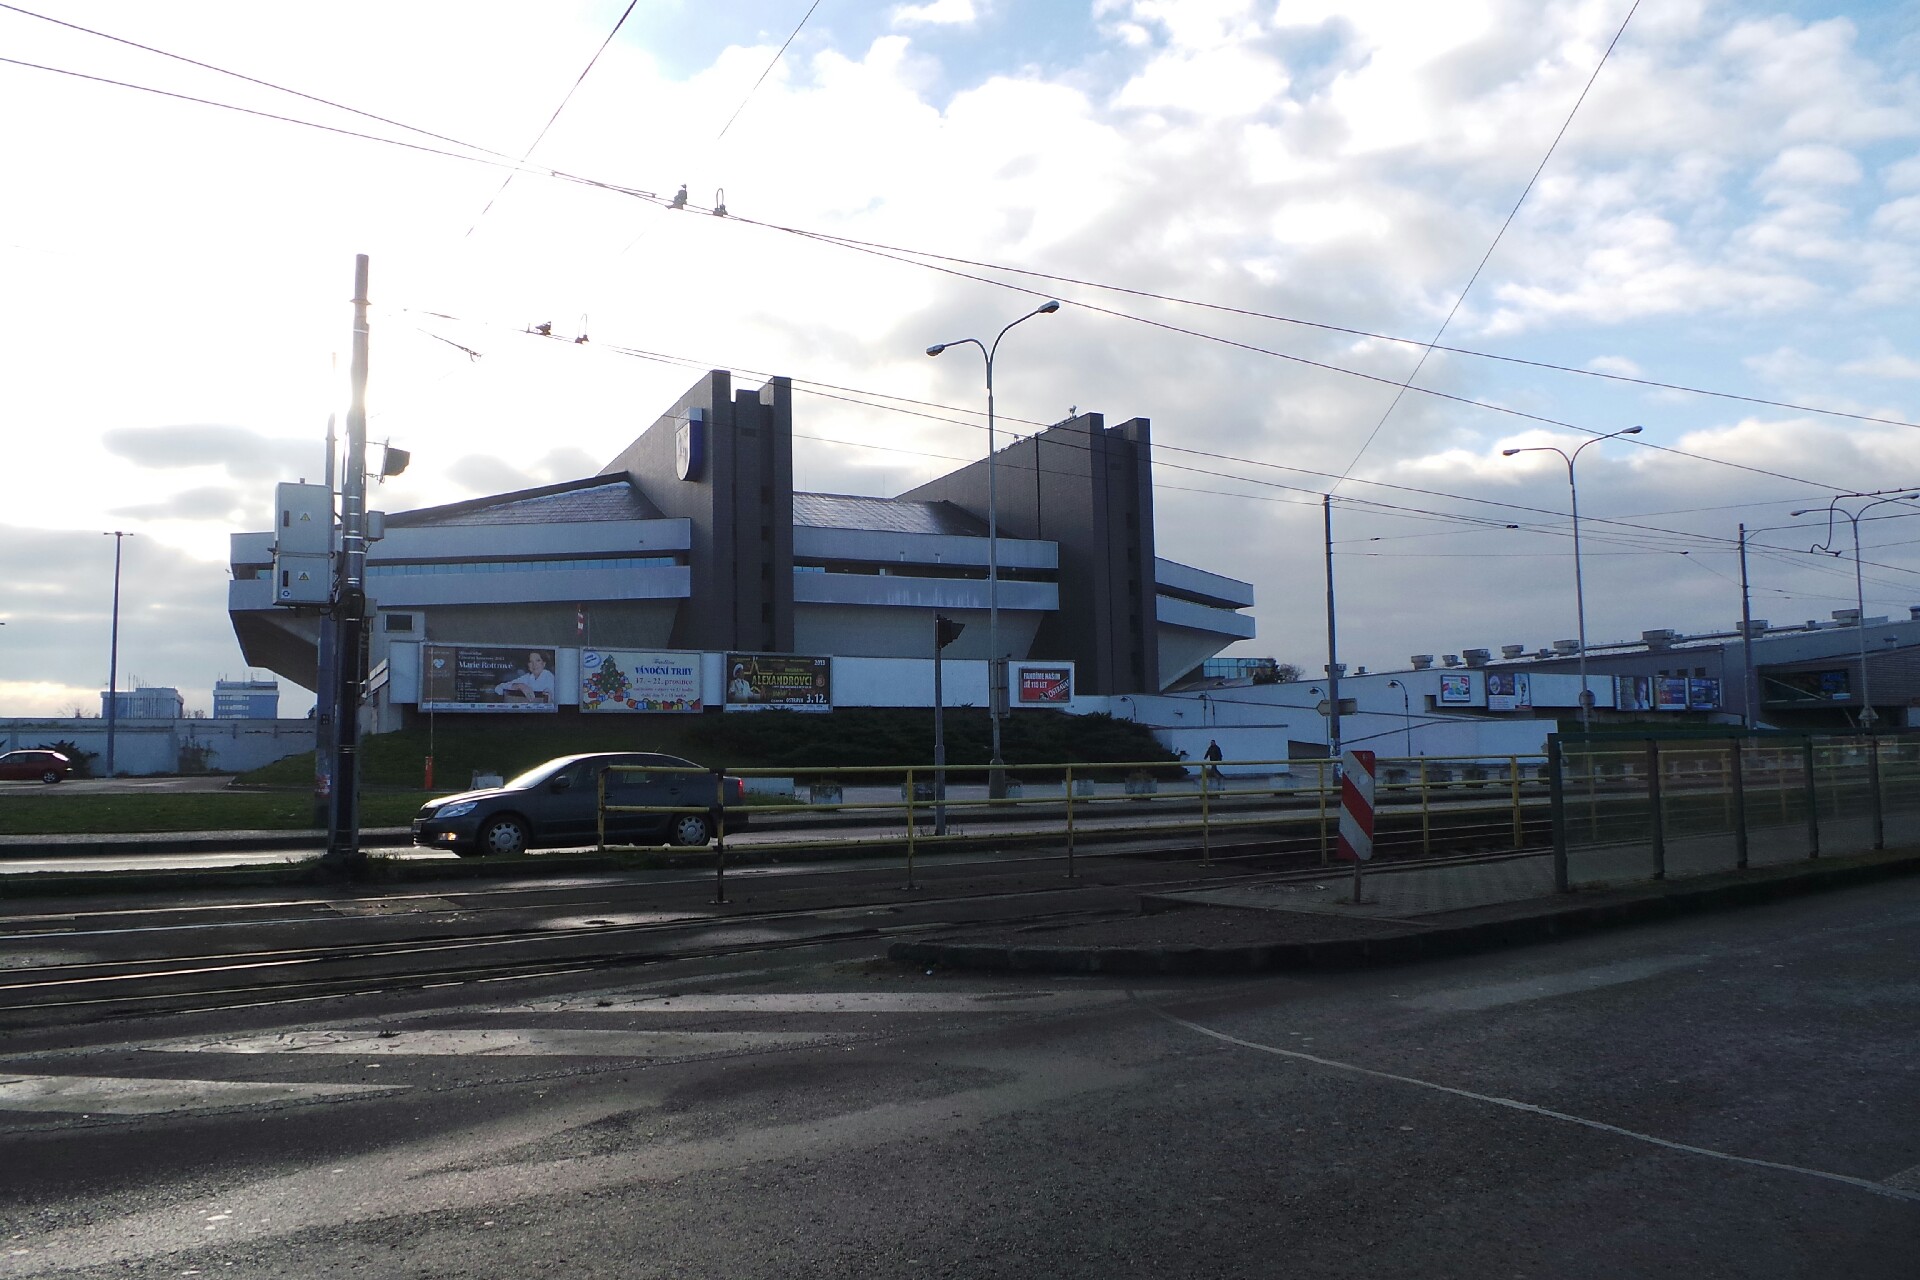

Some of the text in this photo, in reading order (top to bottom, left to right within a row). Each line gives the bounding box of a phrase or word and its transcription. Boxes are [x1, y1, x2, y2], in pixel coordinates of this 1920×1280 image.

[458, 660, 480, 668] Marie
[635, 664, 693, 676] VÁNOČNÍ TRHY
[752, 675, 812, 686] ALEXANDROVCI
